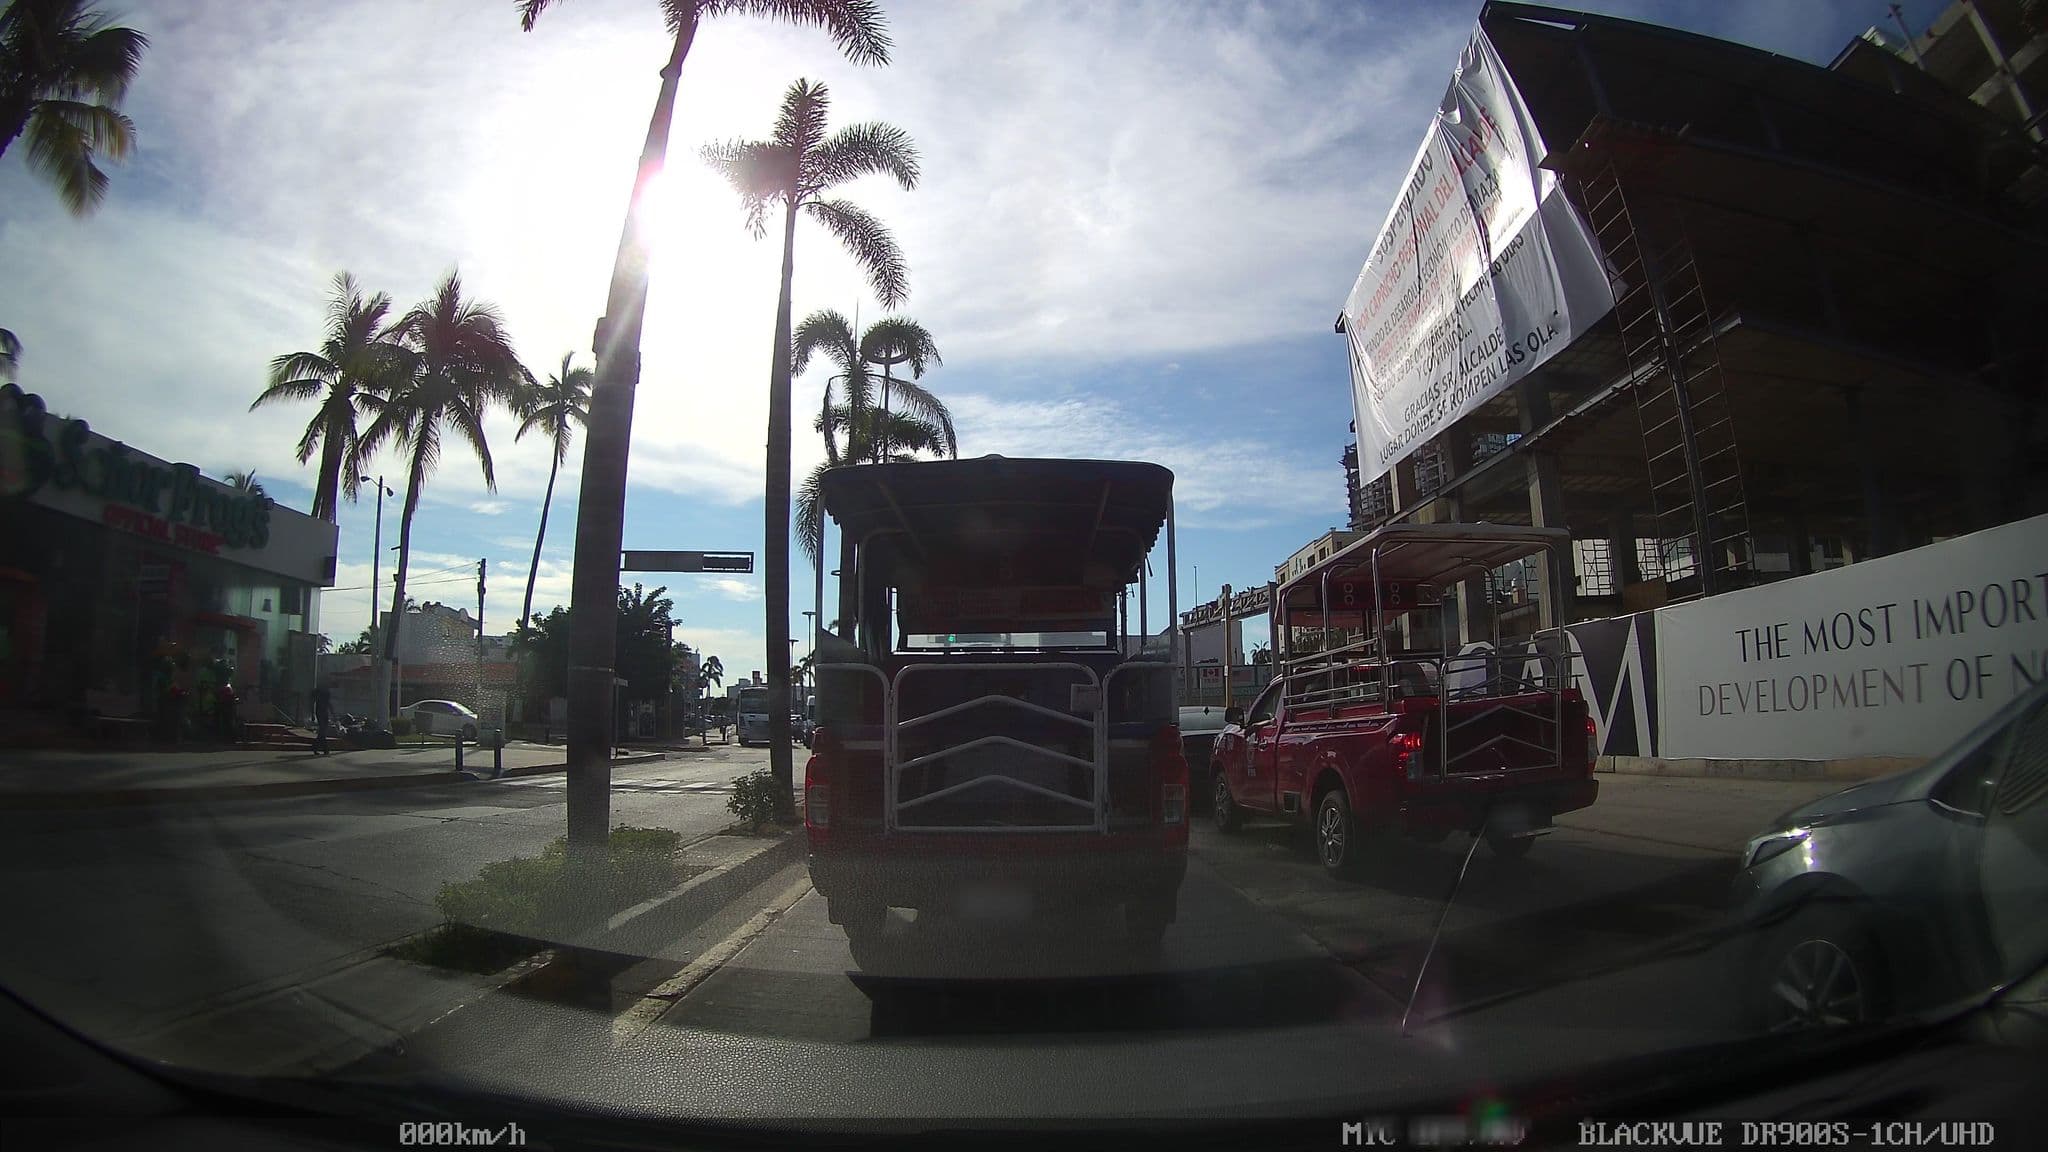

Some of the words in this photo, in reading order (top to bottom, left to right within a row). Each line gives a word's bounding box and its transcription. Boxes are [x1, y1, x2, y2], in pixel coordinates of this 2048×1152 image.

[1431, 173, 1455, 209] DEL
[1378, 433, 1403, 463] LUGAR
[1405, 408, 1435, 443] DONDE
[1436, 398, 1447, 420] SE
[1449, 362, 1497, 411] ROMPEN
[1495, 341, 1526, 374] LAS
[1404, 381, 1442, 422] GRACIAS
[1460, 326, 1503, 380] ALCALDE
[1735, 622, 1791, 663] THE
[1803, 602, 1897, 656] MOST
[1699, 662, 1929, 717] DEVELOPMENT
[1946, 654, 1993, 701] OF
